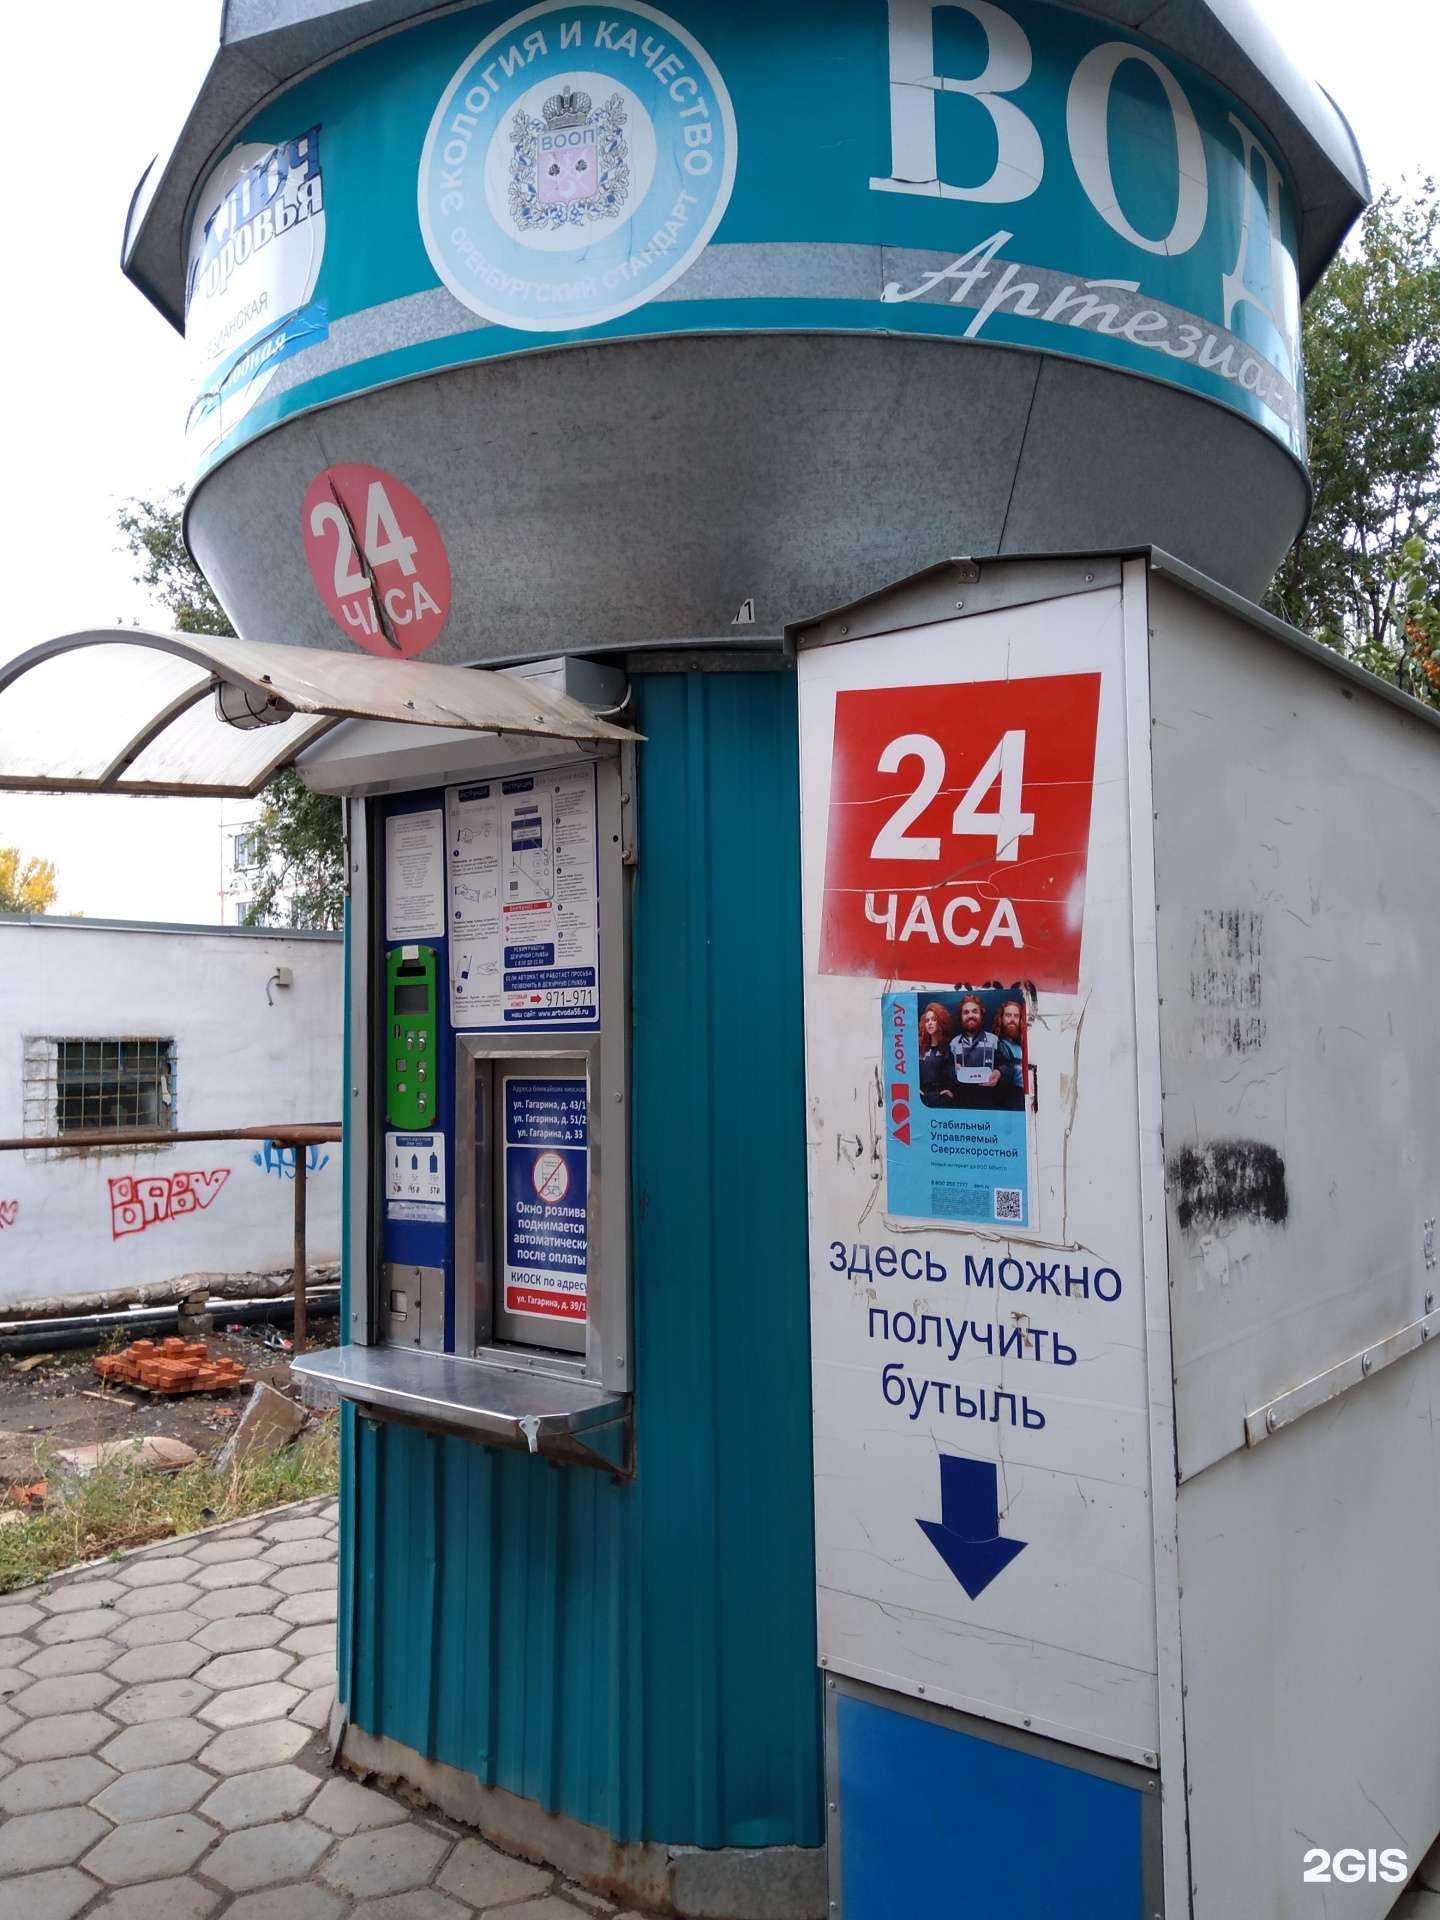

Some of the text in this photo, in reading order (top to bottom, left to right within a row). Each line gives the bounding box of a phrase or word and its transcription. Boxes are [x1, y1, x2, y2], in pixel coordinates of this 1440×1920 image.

[440, 20, 713, 216] ЭКОЛОГИЯ И КАЧЕСТВО
[541, 130, 595, 151] ВООП
[603, 190, 698, 288] СТАНДАРТ
[310, 480, 418, 598] 24
[870, 729, 1035, 861] 24
[864, 893, 1024, 948] ЧАСА
[546, 989, 592, 1007] 971-971
[513, 1101, 524, 1110] ул.
[525, 1100, 560, 1111] Гагарина,
[513, 1115, 524, 1125] ул.
[525, 1114, 560, 1125] Гагарина,
[930, 1120, 991, 1131] Стабильный
[517, 1130, 528, 1138] ул.
[529, 1128, 564, 1139] Гагарина,
[574, 1130, 583, 1139] 33
[930, 1132, 998, 1144] Управляемый
[930, 1144, 1018, 1157] Сверхскоростной
[516, 1201, 586, 1218] Окно розлива
[518, 1219, 585, 1234] поднимается
[517, 1249, 586, 1266] после оплаты
[511, 1272, 541, 1284] КИОСК
[543, 1278, 555, 1287] по
[829, 1241, 1122, 1302] здесь можно
[516, 1295, 526, 1304] ул.
[868, 1307, 1077, 1366] получить
[882, 1363, 1046, 1430] бутыль
